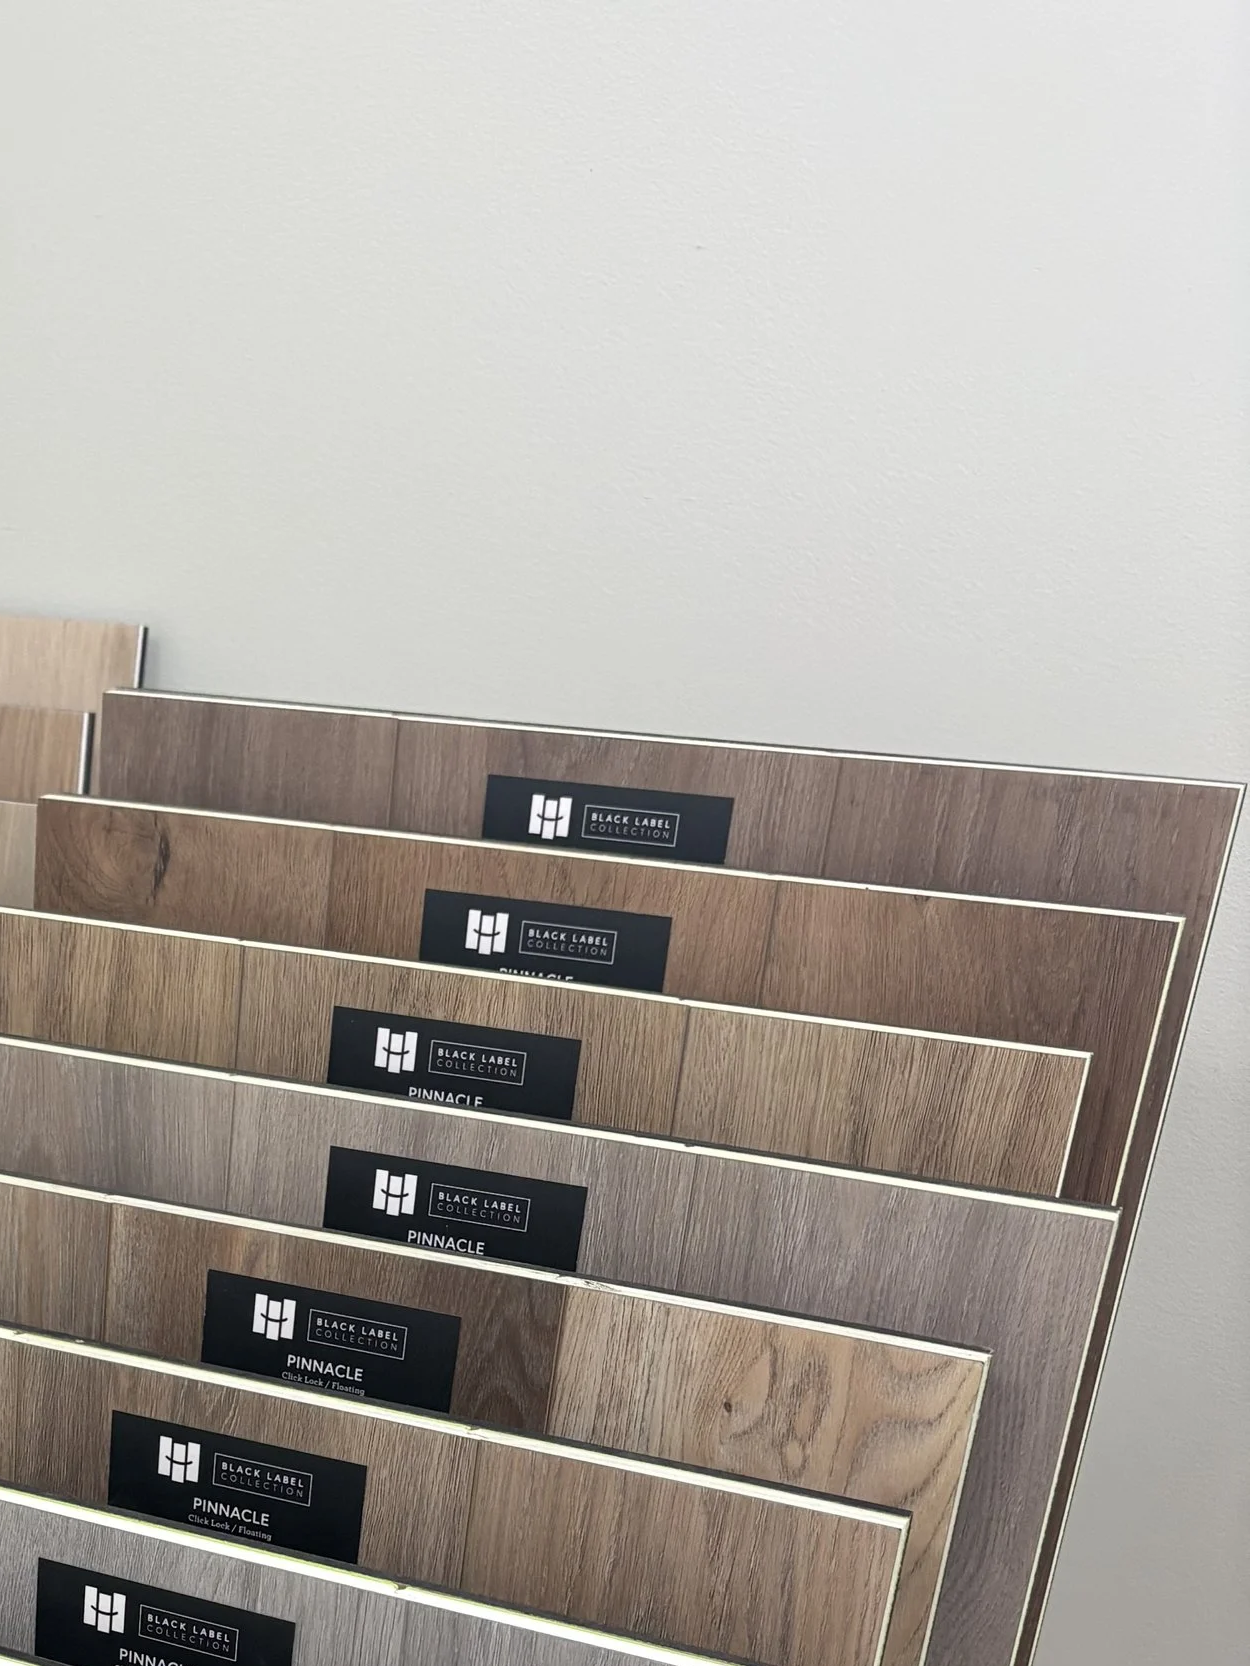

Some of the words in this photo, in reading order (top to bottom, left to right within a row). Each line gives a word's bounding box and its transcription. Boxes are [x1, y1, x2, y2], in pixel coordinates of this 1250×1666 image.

[589, 823, 670, 840] COLLECTION
[591, 812, 629, 825] BLACK
[634, 816, 671, 829] LABEL
[526, 939, 608, 957] COLLECTION
[528, 928, 566, 942] BLACK
[572, 933, 609, 947] LABEL
[436, 1058, 517, 1077] COLLECTION
[438, 1047, 476, 1061] BLACK
[481, 1053, 518, 1067] LABEL
[437, 1202, 521, 1224] COLLECTION
[438, 1191, 478, 1206] BLACK
[484, 1198, 522, 1214] LABEL
[407, 1230, 485, 1256] PINNACLE
[315, 1328, 398, 1352] COLLECTION
[316, 1317, 356, 1333] BLACK
[361, 1326, 399, 1342] LABEL
[286, 1354, 364, 1382] PINNACLE
[281, 1371, 303, 1383] Click
[304, 1376, 324, 1388] Lock
[332, 1381, 365, 1396] Floating
[220, 1472, 304, 1498] COLLECTION
[221, 1461, 261, 1478] BLACK
[266, 1471, 304, 1488] LABEL
[192, 1497, 270, 1527] PINNACLE
[188, 1514, 210, 1527] Click
[211, 1519, 230, 1532] Lock
[238, 1525, 272, 1542] Floating
[146, 1624, 230, 1653] COLLECTION
[147, 1614, 187, 1631] BLACK
[192, 1625, 231, 1643] LABEL
